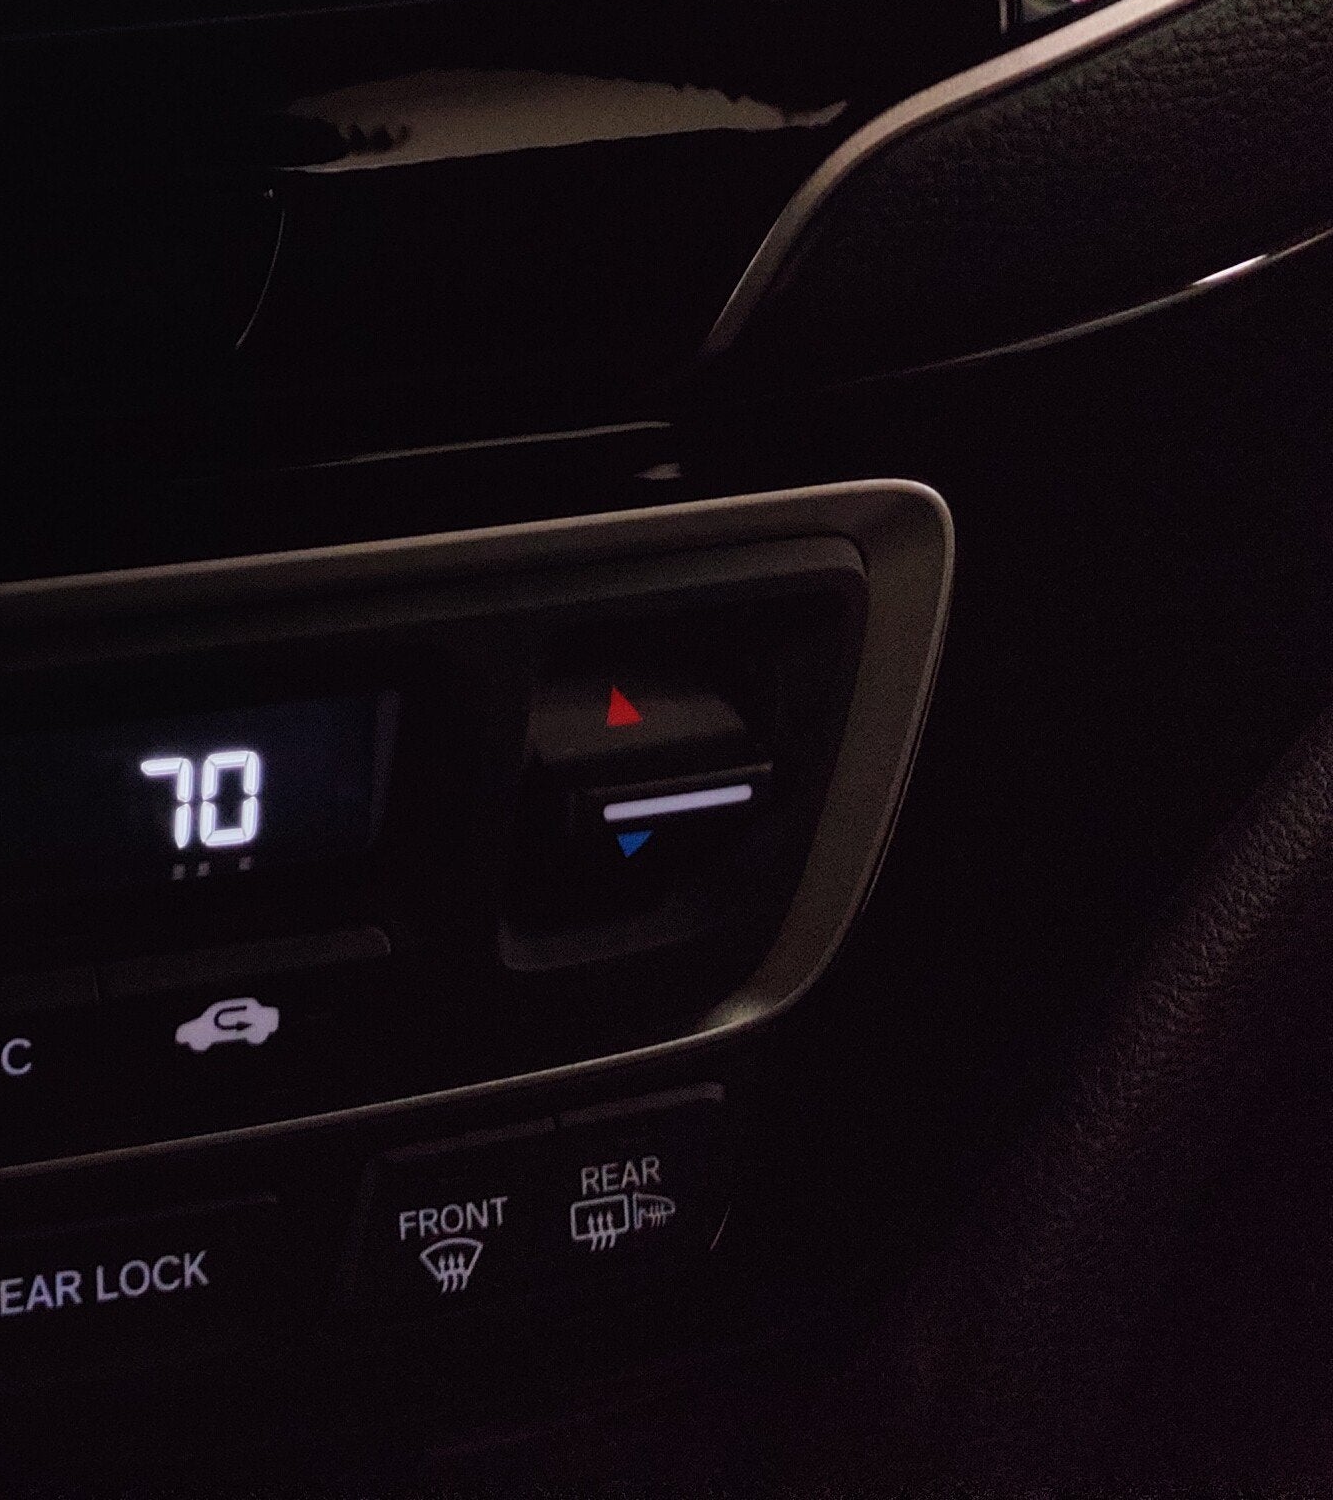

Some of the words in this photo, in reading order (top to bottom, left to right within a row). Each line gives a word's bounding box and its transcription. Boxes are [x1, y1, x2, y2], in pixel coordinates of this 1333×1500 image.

[139, 748, 261, 850] 70
[580, 1156, 662, 1195] REAR
[397, 1195, 509, 1240] FRONT
[94, 1249, 211, 1304] LOCK
